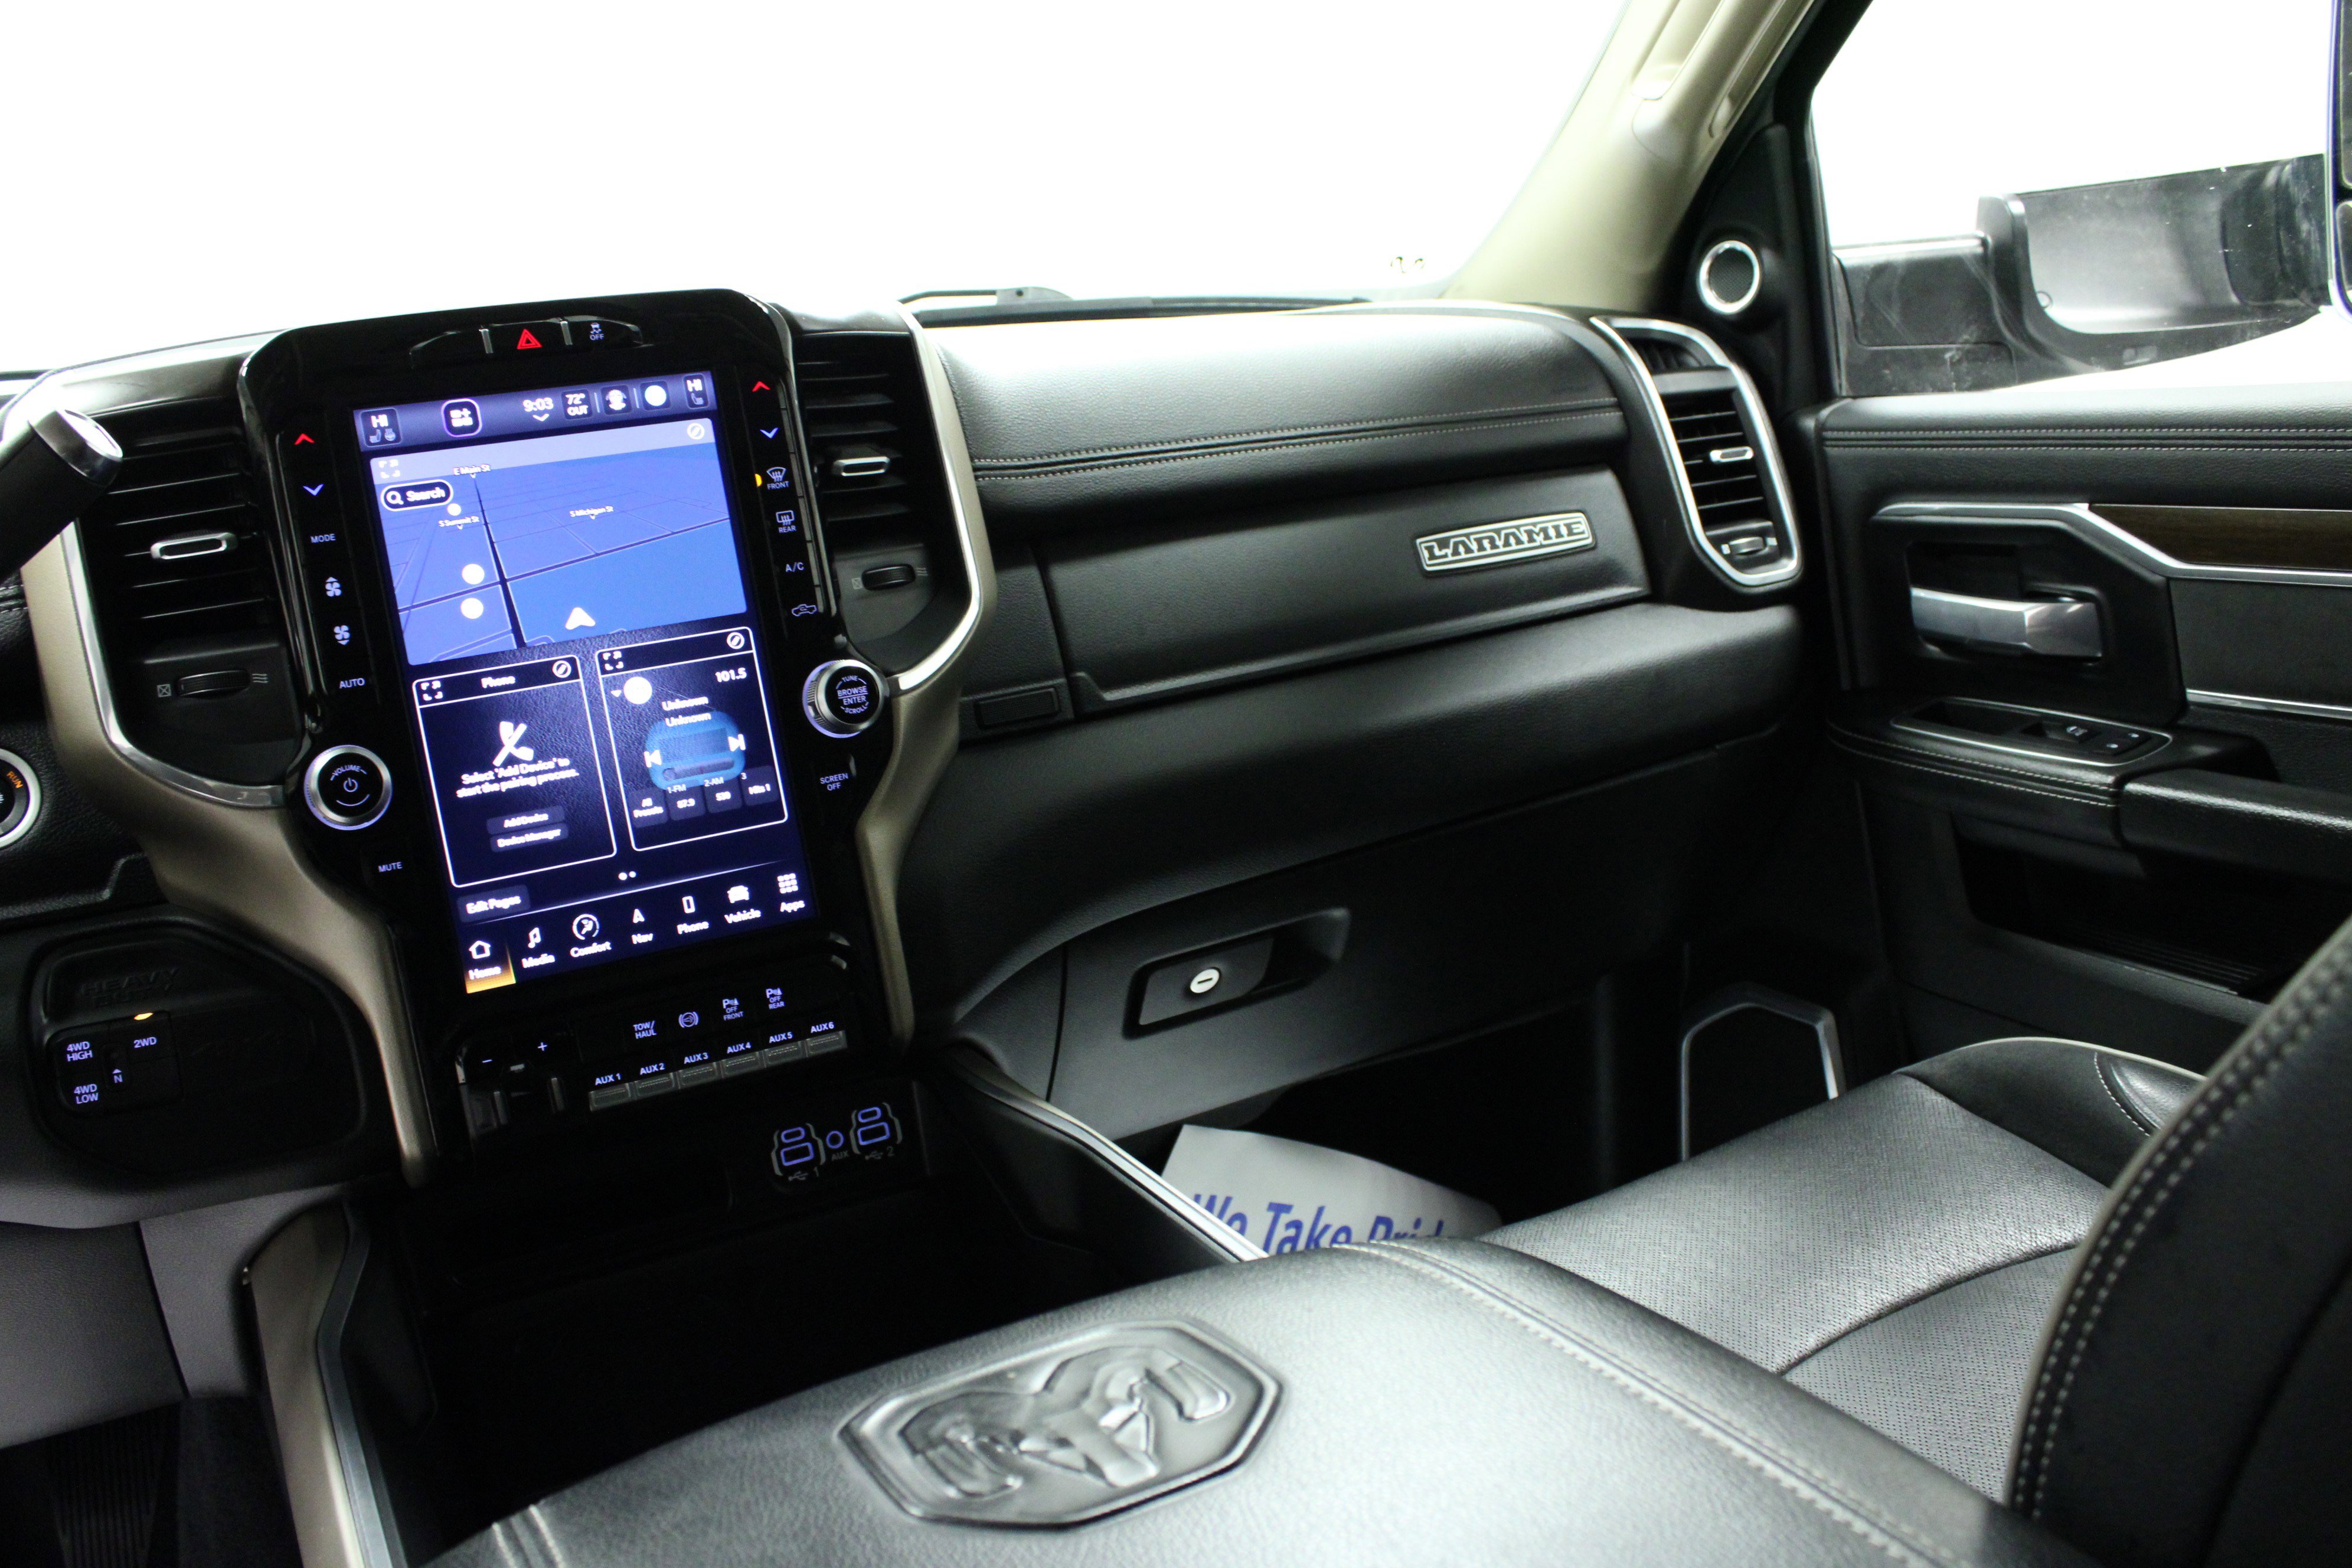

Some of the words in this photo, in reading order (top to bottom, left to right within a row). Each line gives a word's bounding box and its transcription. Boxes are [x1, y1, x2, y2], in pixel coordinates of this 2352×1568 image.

[687, 378, 703, 392] HI
[522, 397, 554, 412] 9:03
[567, 404, 588, 416] OUT
[371, 414, 388, 428] HI
[453, 467, 460, 475] E
[460, 465, 481, 474] Main
[481, 464, 491, 472] St
[767, 481, 789, 490] FRONT
[407, 487, 446, 502] Search
[311, 533, 337, 544] MODE
[1422, 520, 1588, 563] LARAMIE
[785, 561, 805, 572] A/C
[715, 667, 747, 683] 101.5
[339, 678, 365, 689] AUTO
[481, 675, 516, 688] Phone
[837, 685, 868, 697] BROWSE
[661, 696, 709, 711] Unknown
[843, 695, 867, 705] ENTER
[844, 705, 868, 714] SCROLL
[665, 712, 711, 727] Unknown
[332, 765, 361, 777] VOLUME
[6, 770, 24, 789] RUN
[461, 770, 495, 785] Select
[820, 773, 849, 785] SCREEN
[481, 782, 501, 793] the
[827, 782, 841, 791] OFF
[378, 861, 403, 873] MUTE
[466, 899, 489, 914] Edit
[488, 895, 521, 911] Pages
[780, 899, 805, 913] Apps
[724, 908, 762, 925] Vehicle
[677, 919, 710, 935] Phone
[632, 932, 654, 945] Nav
[570, 941, 612, 958] Comfort
[521, 953, 556, 969] Media
[468, 965, 502, 980] Home
[726, 1005, 739, 1014] OFF
[768, 1001, 785, 1010] REAR
[723, 1011, 744, 1021] FRONT
[633, 1020, 655, 1031] TOW/
[810, 1023, 829, 1034] AUX
[828, 1021, 835, 1030] 6
[635, 1030, 657, 1040] HAUL
[769, 1033, 787, 1044] AUX
[787, 1031, 793, 1040] 5
[66, 1041, 90, 1052] 4WD
[133, 1036, 158, 1048] 2WD
[726, 1043, 745, 1054] AUX
[745, 1041, 752, 1050] 4
[66, 1050, 93, 1062] HIGH
[684, 1054, 702, 1064] AUX
[702, 1052, 709, 1060] 3
[639, 1064, 658, 1075] AUX
[658, 1063, 666, 1072] 2
[113, 1074, 123, 1083] N
[594, 1074, 613, 1086] AUX
[615, 1073, 622, 1081] 1
[74, 1083, 97, 1095] 4WD
[76, 1093, 99, 1105] LOW
[831, 1151, 849, 1161] AUX
[886, 1145, 895, 1157] 2
[813, 1166, 819, 1178] 1
[1262, 1202, 1353, 1255] Take
